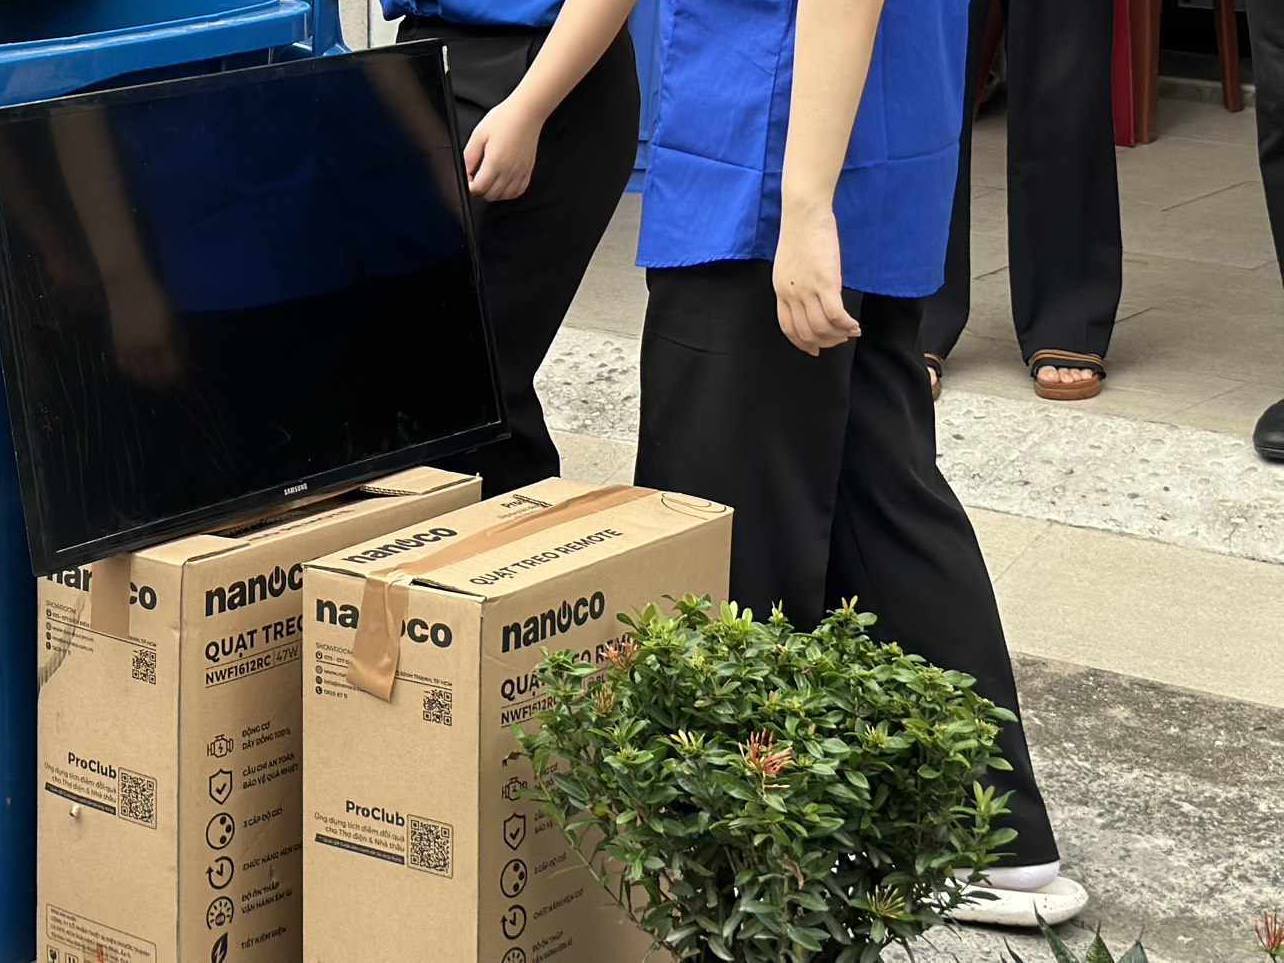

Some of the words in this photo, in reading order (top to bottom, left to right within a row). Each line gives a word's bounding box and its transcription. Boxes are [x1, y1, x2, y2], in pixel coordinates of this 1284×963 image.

[284, 482, 308, 496] SAMSUNG
[469, 566, 519, 586] QUẠT
[511, 551, 561, 574] TREO
[554, 528, 624, 555] REMOTE
[205, 629, 258, 662] QUẠT
[205, 654, 272, 686] NWF1612RC
[68, 751, 118, 780] ProClub
[345, 799, 406, 828] ProClub
[325, 825, 338, 835] cho
